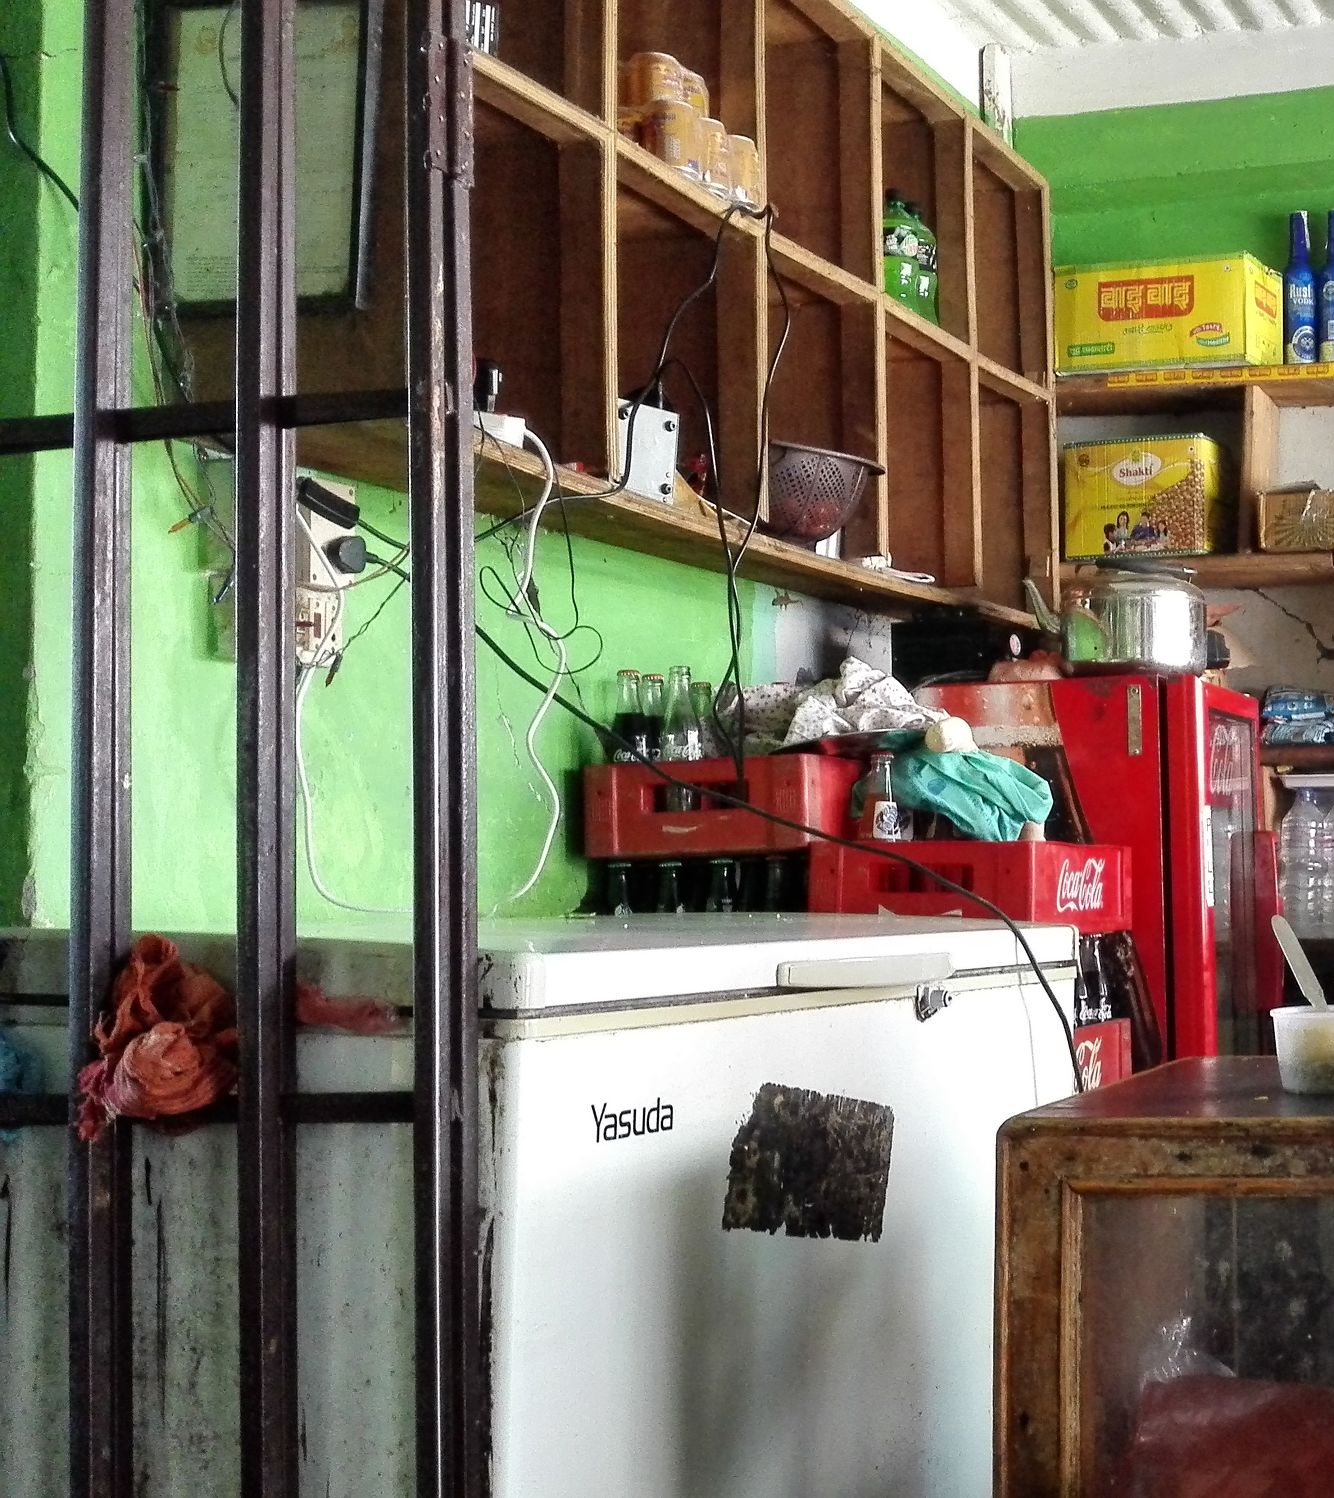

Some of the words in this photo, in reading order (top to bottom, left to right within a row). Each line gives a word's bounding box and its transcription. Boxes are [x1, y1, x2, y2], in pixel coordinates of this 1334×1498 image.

[1119, 463, 1153, 478] Shakti
[1056, 857, 1105, 912] Coca-Cola
[590, 1096, 674, 1144] Yasuda
